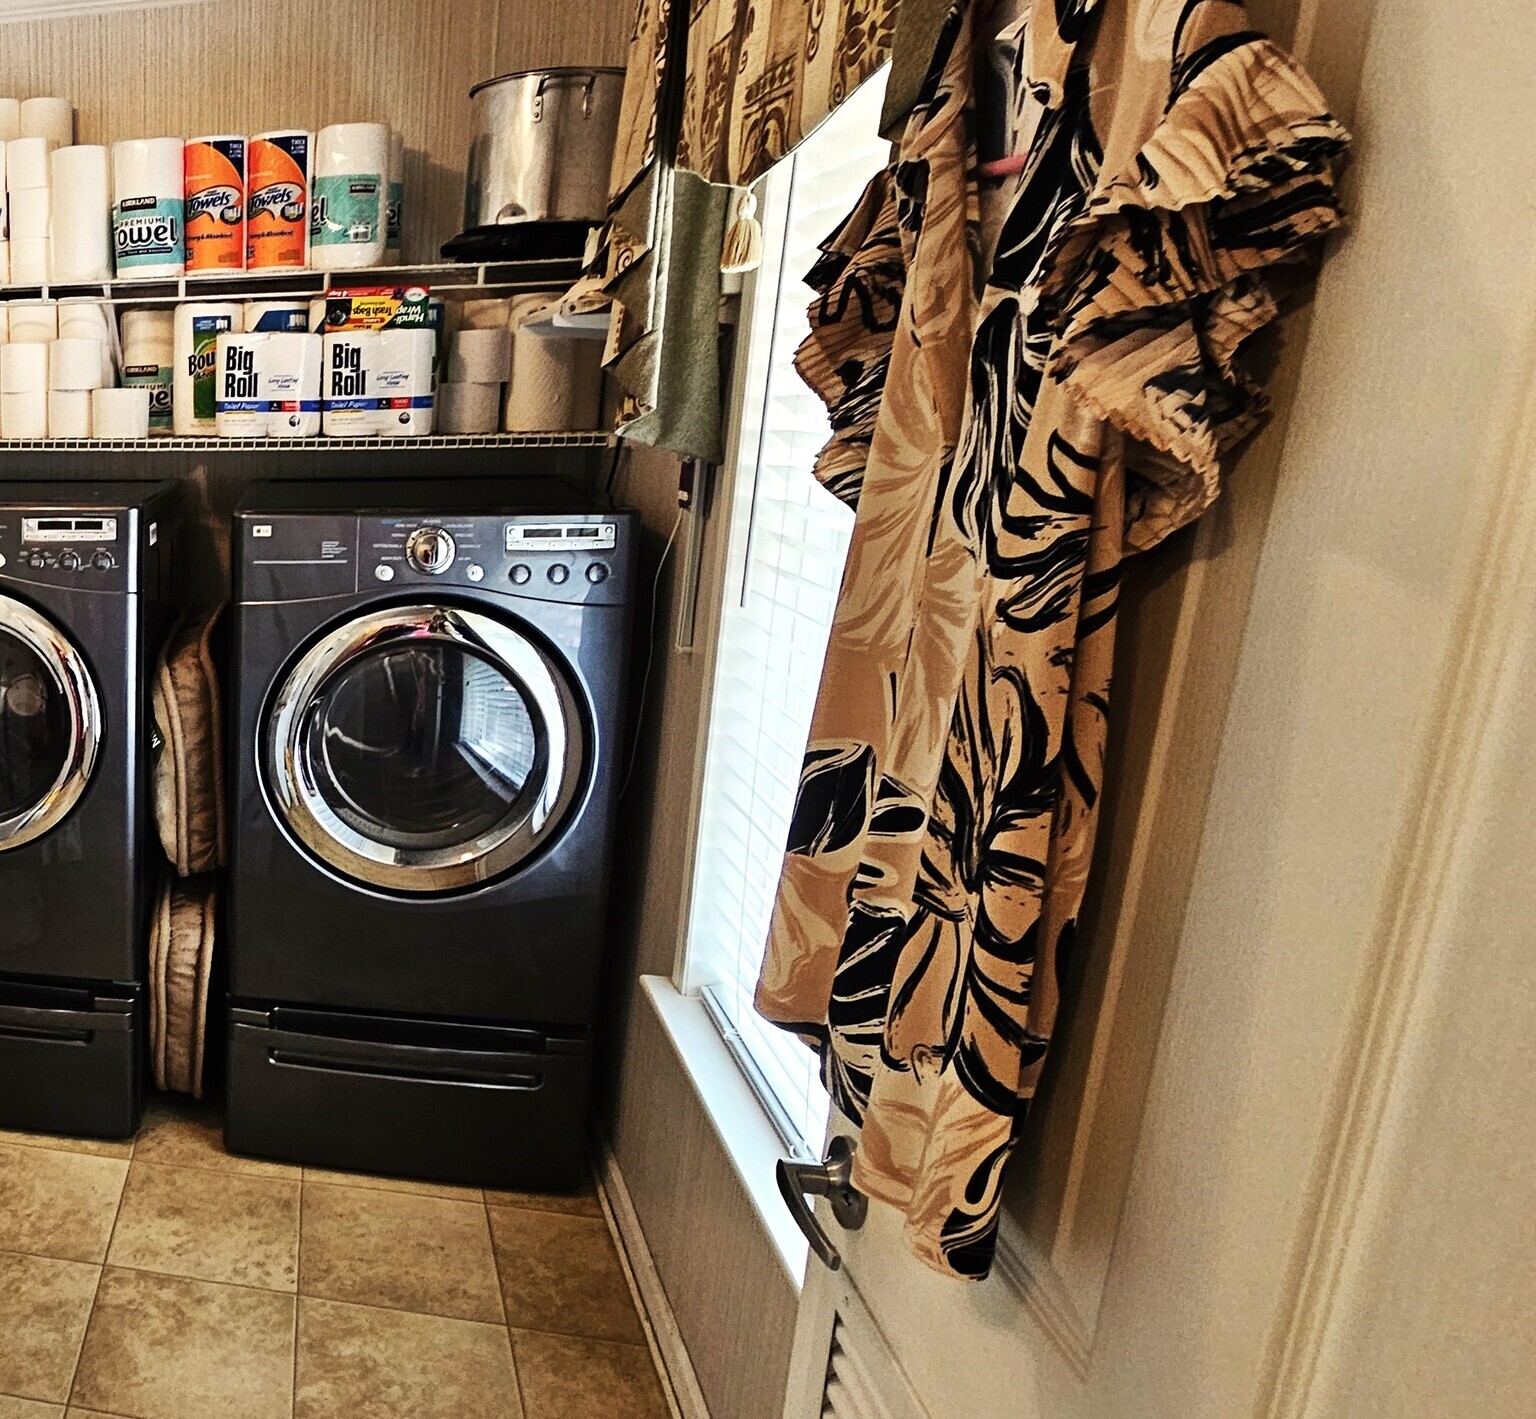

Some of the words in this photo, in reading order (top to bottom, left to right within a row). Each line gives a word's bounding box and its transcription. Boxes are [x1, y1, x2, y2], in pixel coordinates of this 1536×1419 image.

[187, 191, 232, 215] Towels
[250, 188, 293, 213] Towels
[114, 217, 177, 247] owel
[120, 216, 162, 227] PREMIUM
[353, 306, 371, 316] Bags
[372, 306, 392, 316] Trash
[393, 313, 424, 325] Handi-
[396, 305, 421, 316] Wrap
[188, 351, 216, 376] Bou
[226, 346, 254, 375] Big
[332, 343, 361, 373] Big
[225, 373, 258, 397] Roll
[331, 370, 366, 396] Roll
